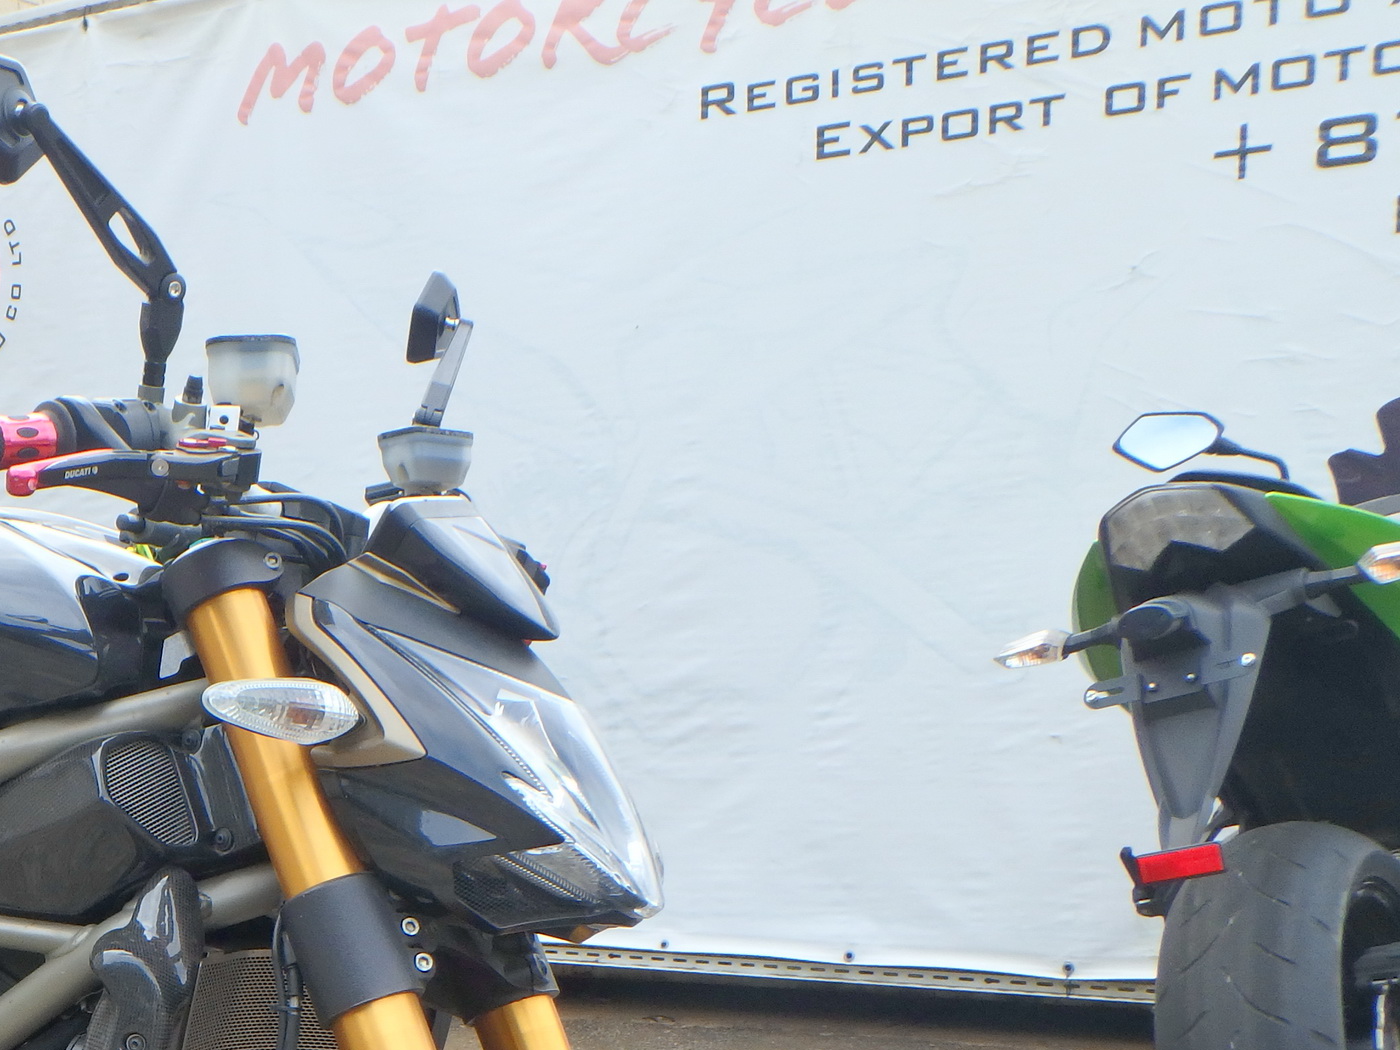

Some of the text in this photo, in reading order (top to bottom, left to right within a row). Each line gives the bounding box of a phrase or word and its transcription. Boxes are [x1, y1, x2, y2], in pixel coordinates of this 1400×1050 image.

[700, 0, 1400, 120] REGISTERED MOTO
[815, 93, 1066, 160] EXPORT
[1104, 73, 1192, 117] OF
[3, 218, 22, 266] LTD
[5, 283, 22, 321] CO
[64, 466, 92, 480] DUCATI
